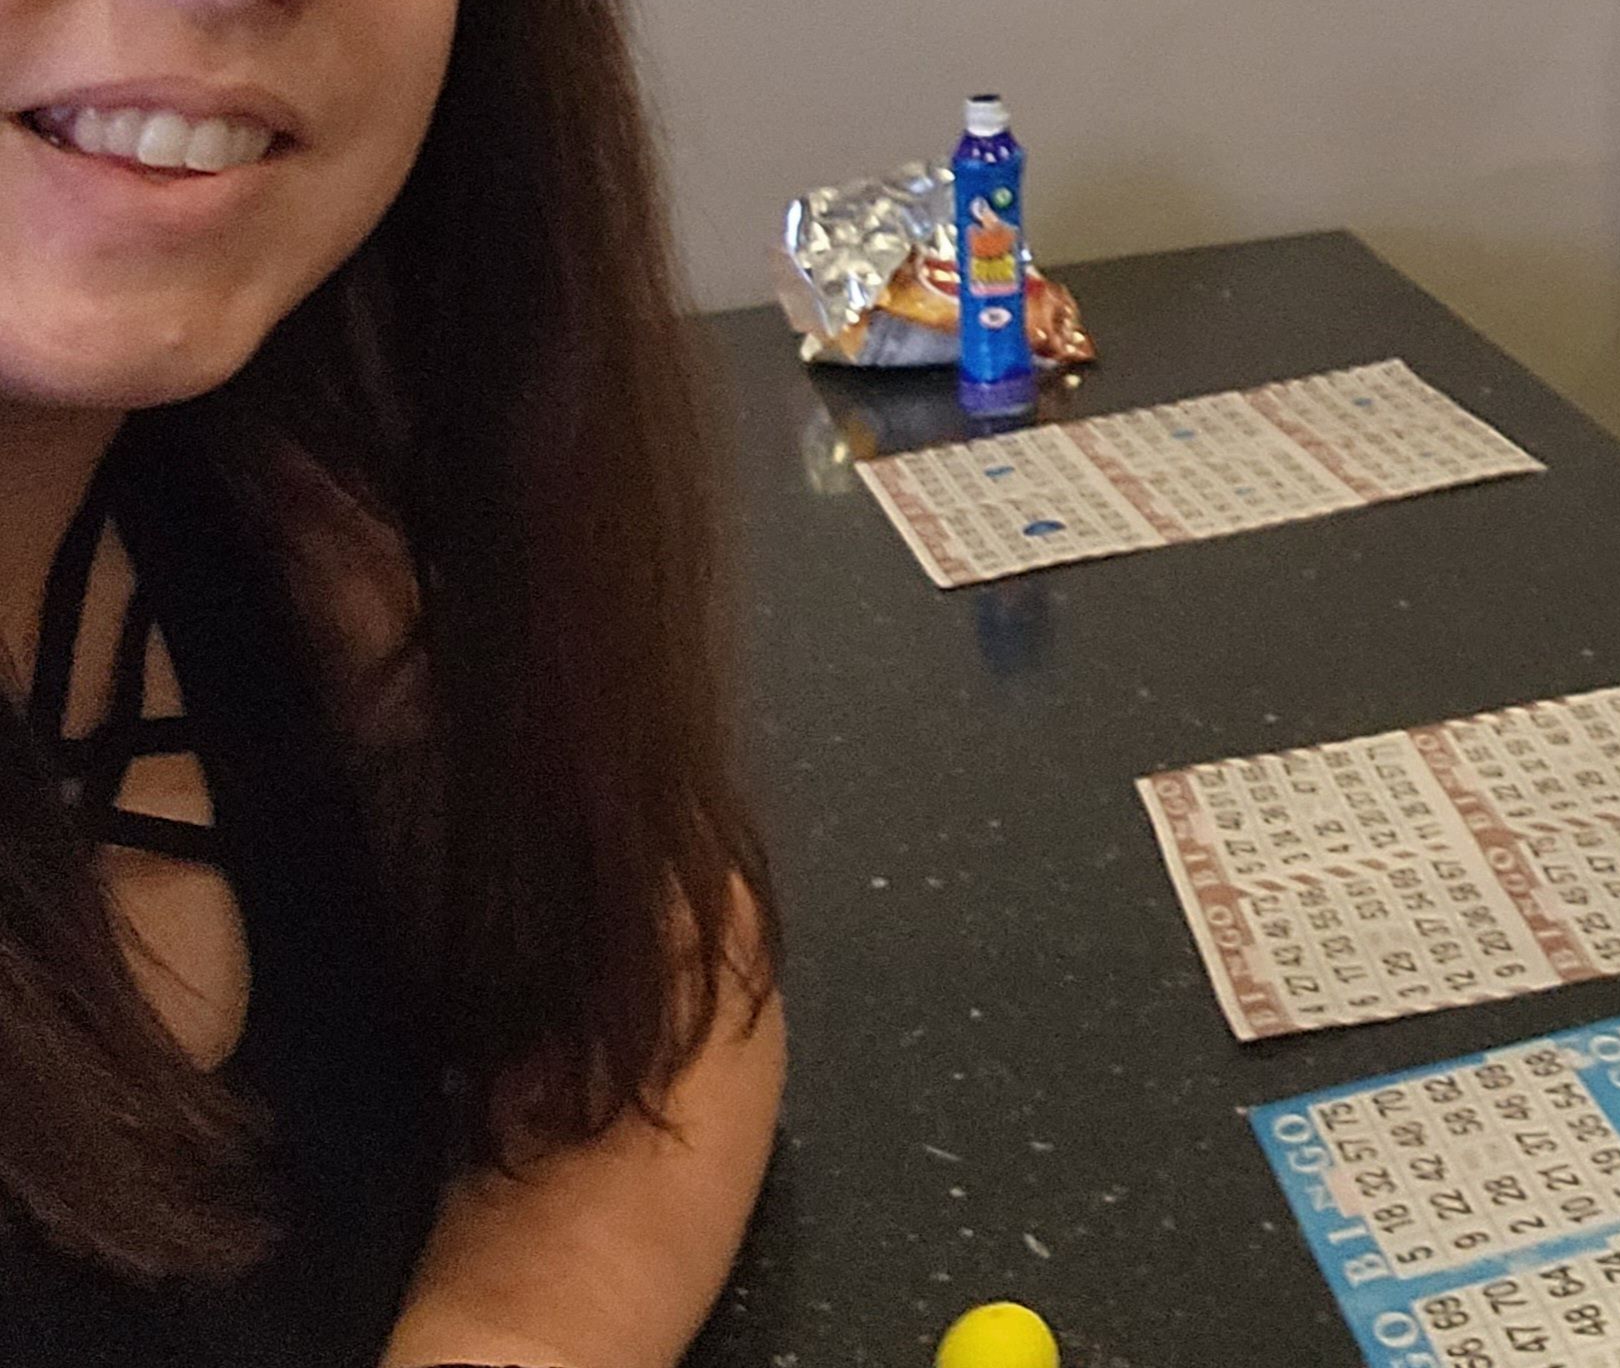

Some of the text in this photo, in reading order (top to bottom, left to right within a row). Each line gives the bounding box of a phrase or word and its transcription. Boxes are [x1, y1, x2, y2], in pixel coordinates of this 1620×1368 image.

[1541, 864, 1577, 884] 57
[1585, 855, 1616, 873] 47
[1413, 918, 1450, 938] 37
[1428, 941, 1462, 964] 19
[1272, 944, 1320, 996] 27 43
[1331, 965, 1365, 984] 17
[1443, 970, 1476, 991] 12
[1494, 963, 1526, 978] 9
[1423, 1076, 1462, 1103] 62
[1544, 1082, 1586, 1109] 54
[1371, 1089, 1406, 1118] 70
[1566, 1113, 1610, 1142] 35
[1513, 1132, 1557, 1156] 37
[1408, 1154, 1445, 1181] 42
[1537, 1164, 1581, 1191] 21
[1318, 1102, 1433, 1264] 5 18 32 57 75
[1483, 1175, 1527, 1205] 28
[1428, 1189, 1473, 1220] 22
[1559, 1196, 1600, 1223] 10
[1508, 1216, 1546, 1234] 2
[1453, 1231, 1489, 1249] 9
[1423, 1296, 1469, 1330] 69
[1539, 1265, 1605, 1335] 48 64
[1482, 1280, 1548, 1352] 47 70
